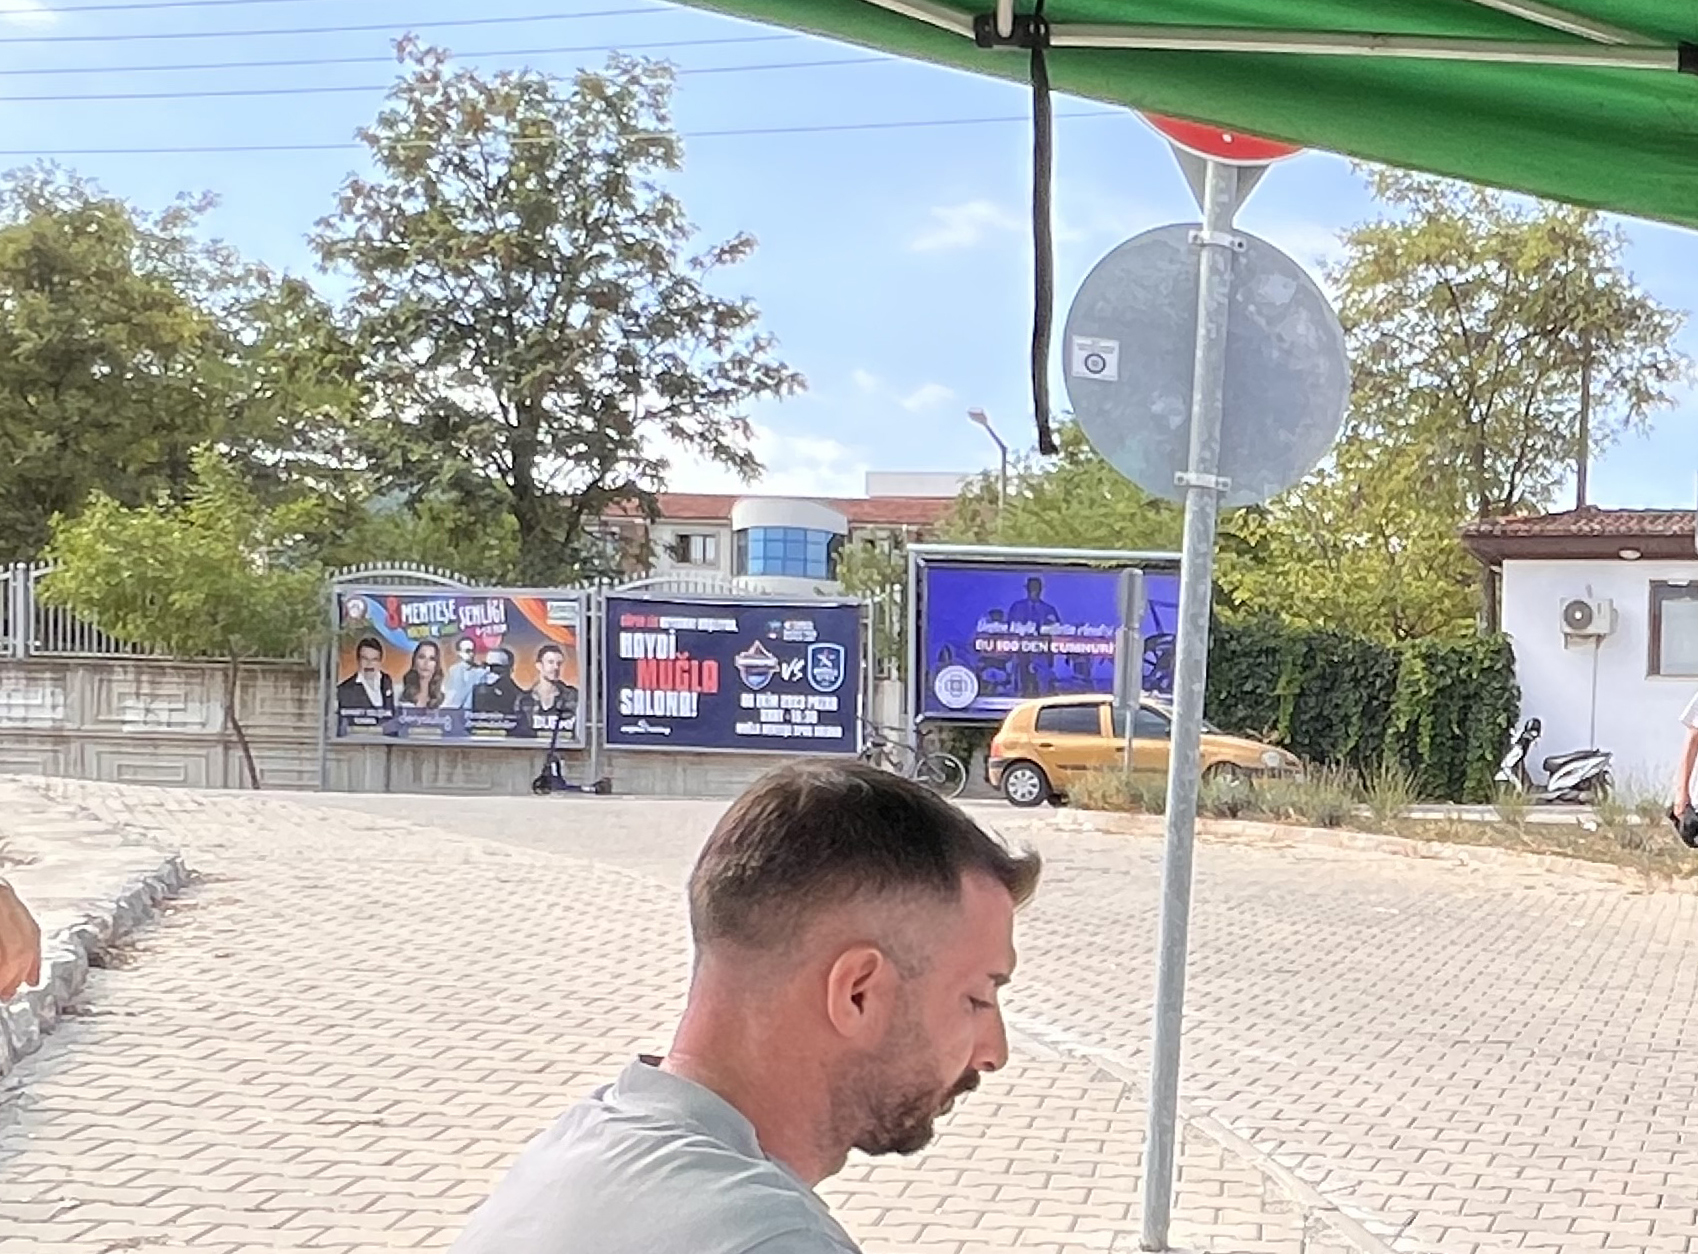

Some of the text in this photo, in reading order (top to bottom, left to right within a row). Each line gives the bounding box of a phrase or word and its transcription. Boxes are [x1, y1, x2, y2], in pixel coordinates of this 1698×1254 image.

[620, 628, 676, 660] HAYDİ
[637, 651, 719, 693] MUĞLA
[781, 657, 806, 681] VS
[620, 688, 698, 718] SALONA!
